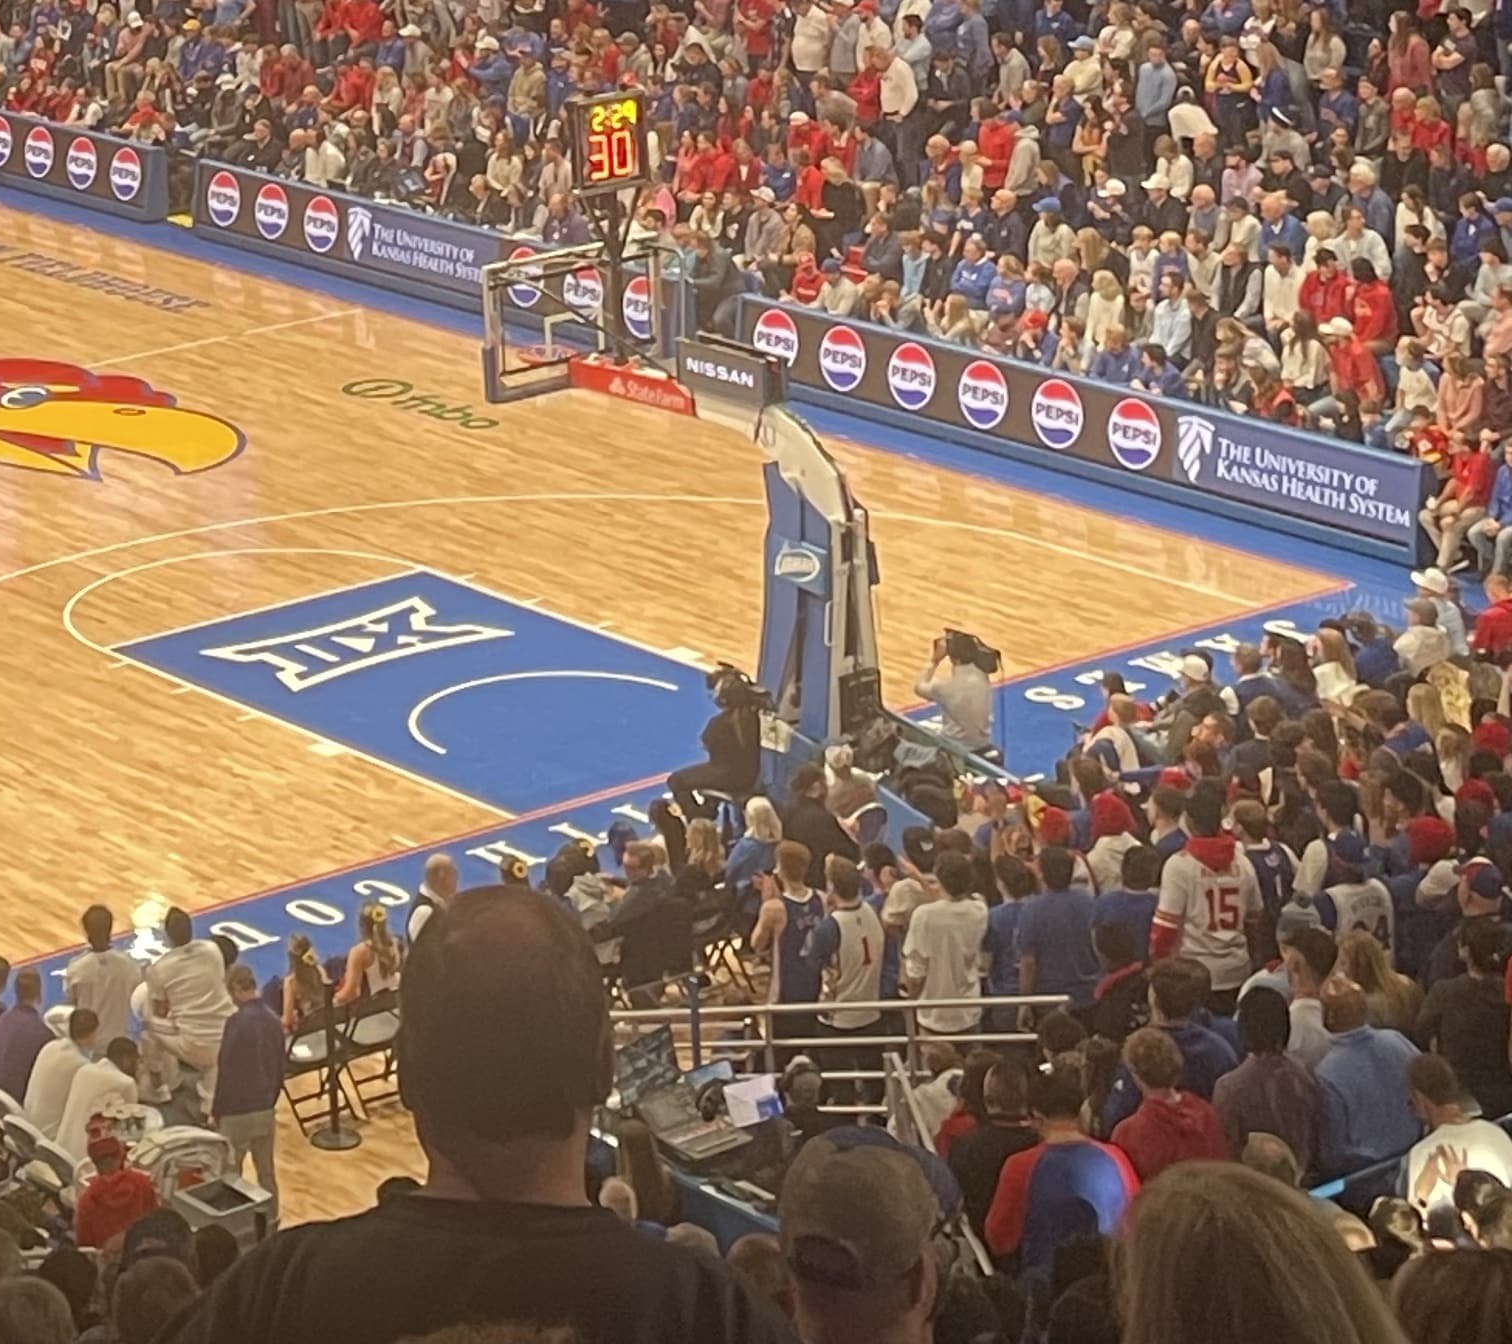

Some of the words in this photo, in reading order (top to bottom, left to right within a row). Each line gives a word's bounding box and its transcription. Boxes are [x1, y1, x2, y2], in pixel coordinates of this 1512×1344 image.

[591, 100, 637, 132] 2:29
[589, 130, 634, 180] 30
[211, 191, 237, 207] PEPSI
[258, 204, 285, 219] PEPSI
[306, 216, 335, 232] PEPSI
[374, 223, 395, 244] THE
[396, 226, 459, 259] UNIVERSITY
[459, 247, 474, 262] OF
[372, 242, 412, 264] KANSAS
[412, 253, 454, 277] HEALTH
[757, 331, 794, 352] PEPSI
[823, 348, 862, 369] PEPSI
[686, 357, 754, 387] NISSAN
[892, 365, 931, 386] PEPSI
[962, 383, 1003, 406] PEPSI
[1036, 402, 1079, 426] PEPSI
[1112, 422, 1156, 445] PEPSI
[1218, 438, 1251, 465] THE
[1254, 447, 1353, 490] UNIVERSITY
[1355, 476, 1379, 497] OF
[1216, 459, 1278, 493] KANSAS
[1281, 476, 1345, 510] HEALTH
[1349, 495, 1410, 527] SYSTEM
[1206, 887, 1239, 932] 15
[861, 936, 872, 965] 1
